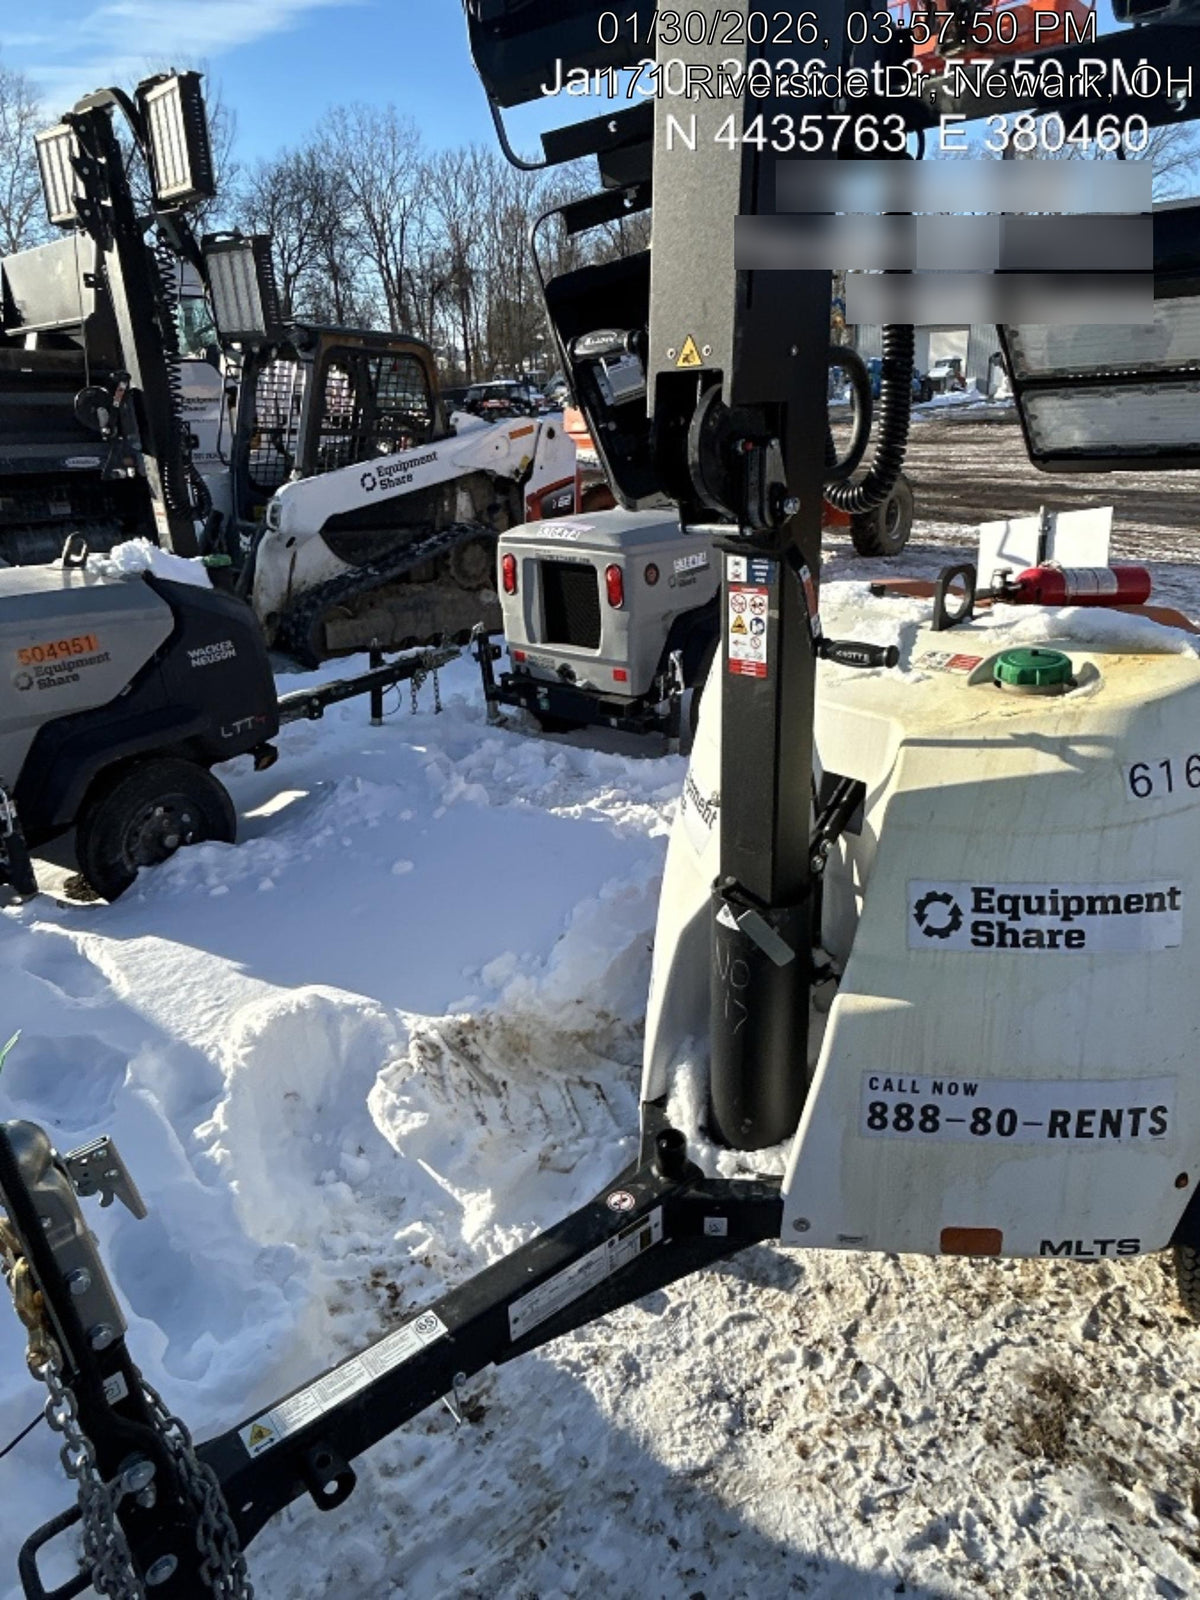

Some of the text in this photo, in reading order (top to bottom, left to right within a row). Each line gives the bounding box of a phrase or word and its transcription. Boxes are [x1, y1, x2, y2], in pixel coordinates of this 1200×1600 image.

[376, 451, 438, 477] Equipment
[380, 473, 413, 490] Share
[18, 635, 95, 666] 504951
[187, 640, 235, 658] WACKER
[191, 648, 237, 668] NEUSON
[33, 652, 112, 678] Equipment
[37, 673, 80, 690] Share
[1129, 754, 1200, 798] 616
[970, 885, 1181, 922] Equipment
[970, 920, 1086, 949] Share
[868, 1077, 979, 1097] CALL NOW
[867, 1101, 1169, 1139] 888-80-RENTS
[1040, 1238, 1141, 1256] MLTS
